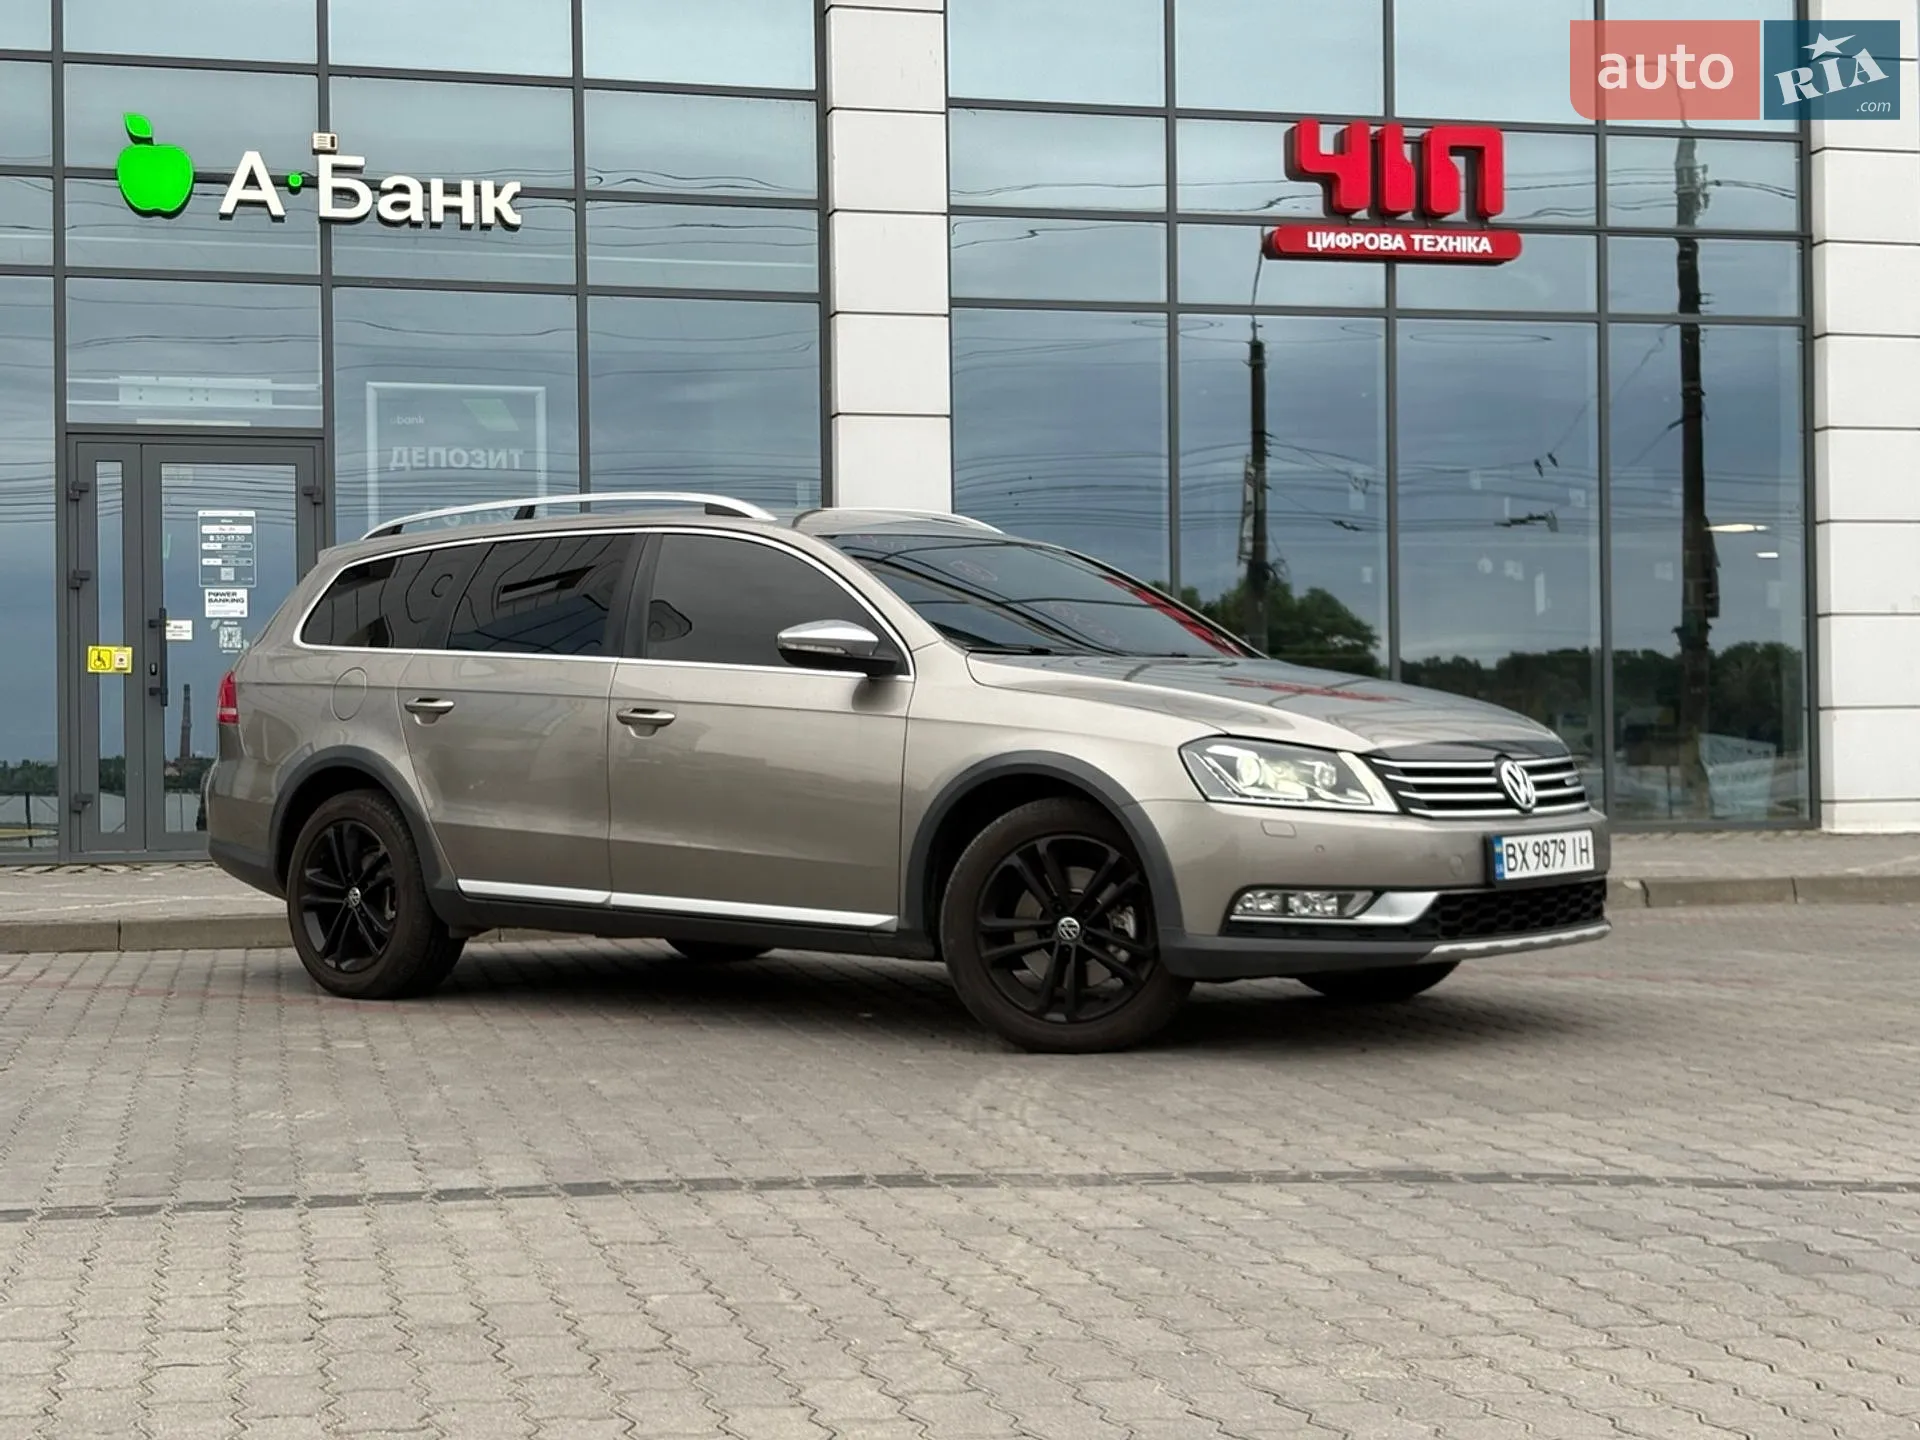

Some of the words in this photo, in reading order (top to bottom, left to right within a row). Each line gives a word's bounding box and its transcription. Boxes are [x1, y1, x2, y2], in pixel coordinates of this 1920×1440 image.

[1289, 117, 1504, 218] ЧІП
[1307, 231, 1407, 251] ЦИФРОВА
[1410, 234, 1493, 254] ТЕХНІКА
[389, 446, 524, 471] ДЕПОЗИТ
[1505, 842, 1530, 872] BX
[1532, 838, 1567, 871] 9879
[1572, 835, 1591, 866] IH
